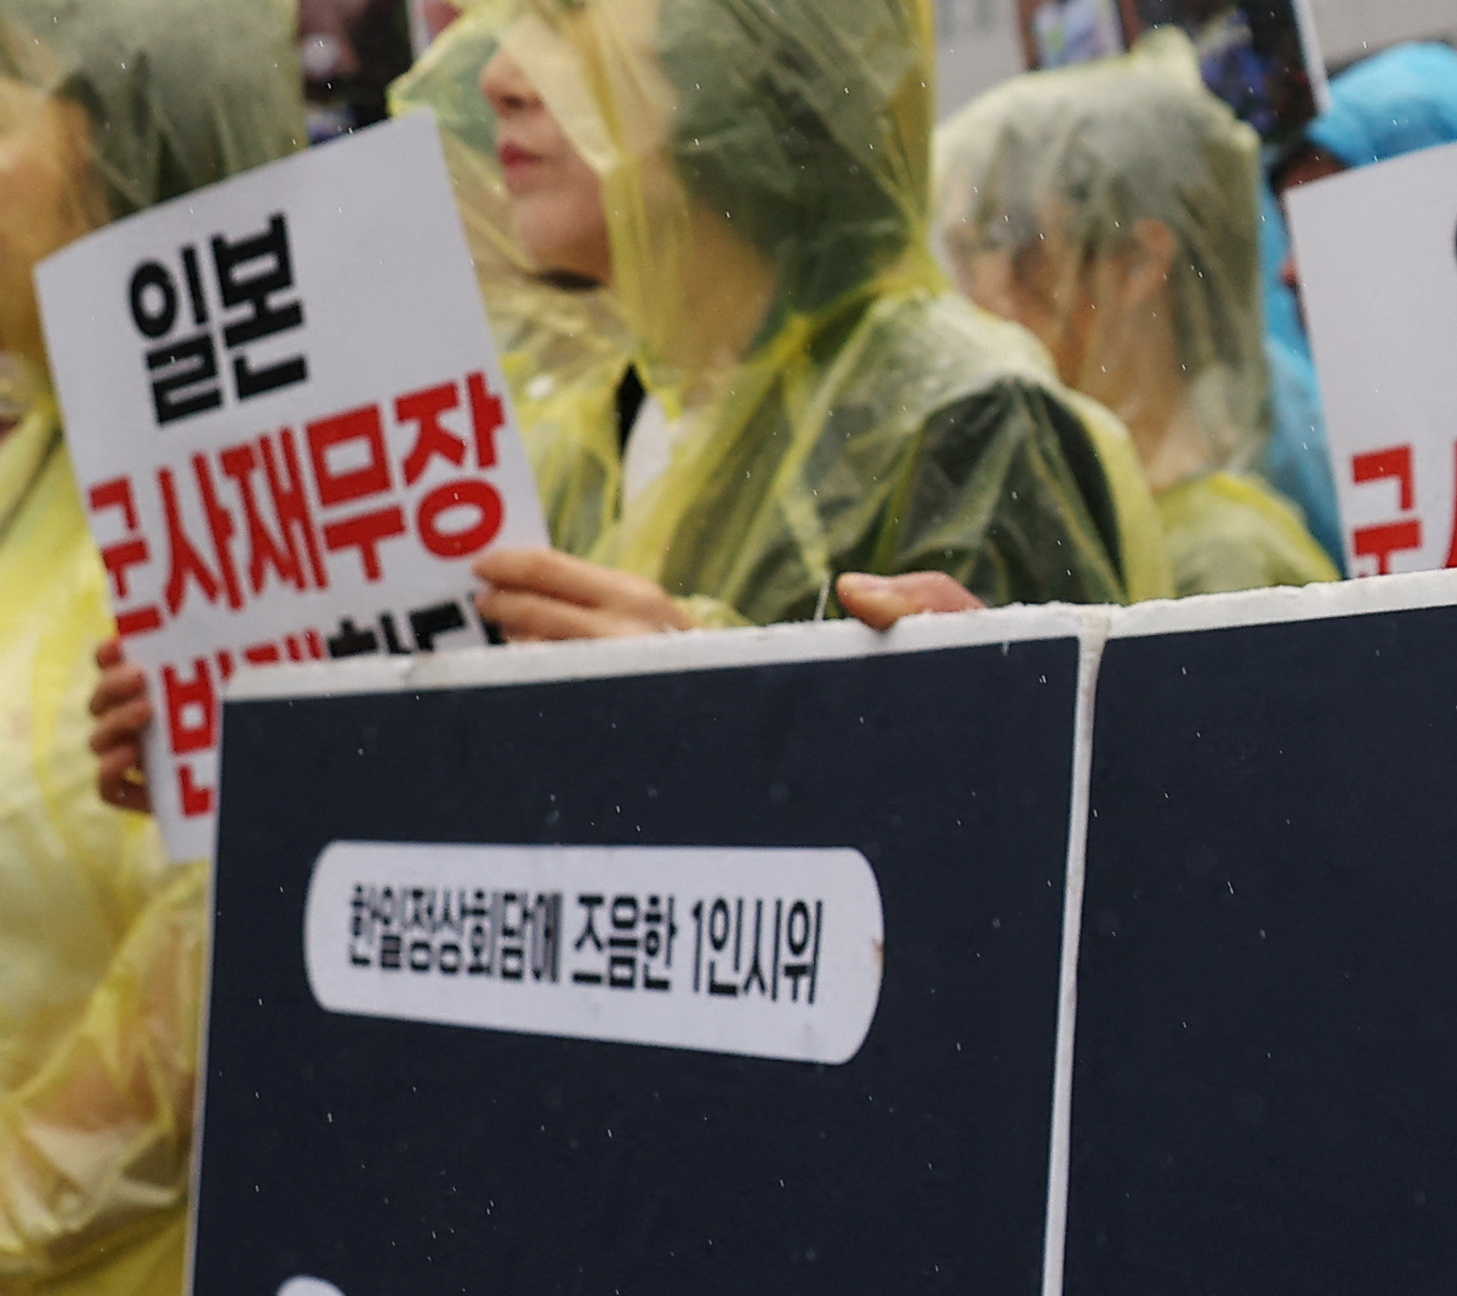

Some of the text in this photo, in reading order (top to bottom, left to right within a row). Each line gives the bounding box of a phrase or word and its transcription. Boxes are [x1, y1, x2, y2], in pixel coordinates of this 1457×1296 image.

[129, 213, 308, 427] 일본
[88, 371, 507, 638] 군사재무장
[350, 882, 824, 1005] 한일정상회담에 즈음한 1인시위
